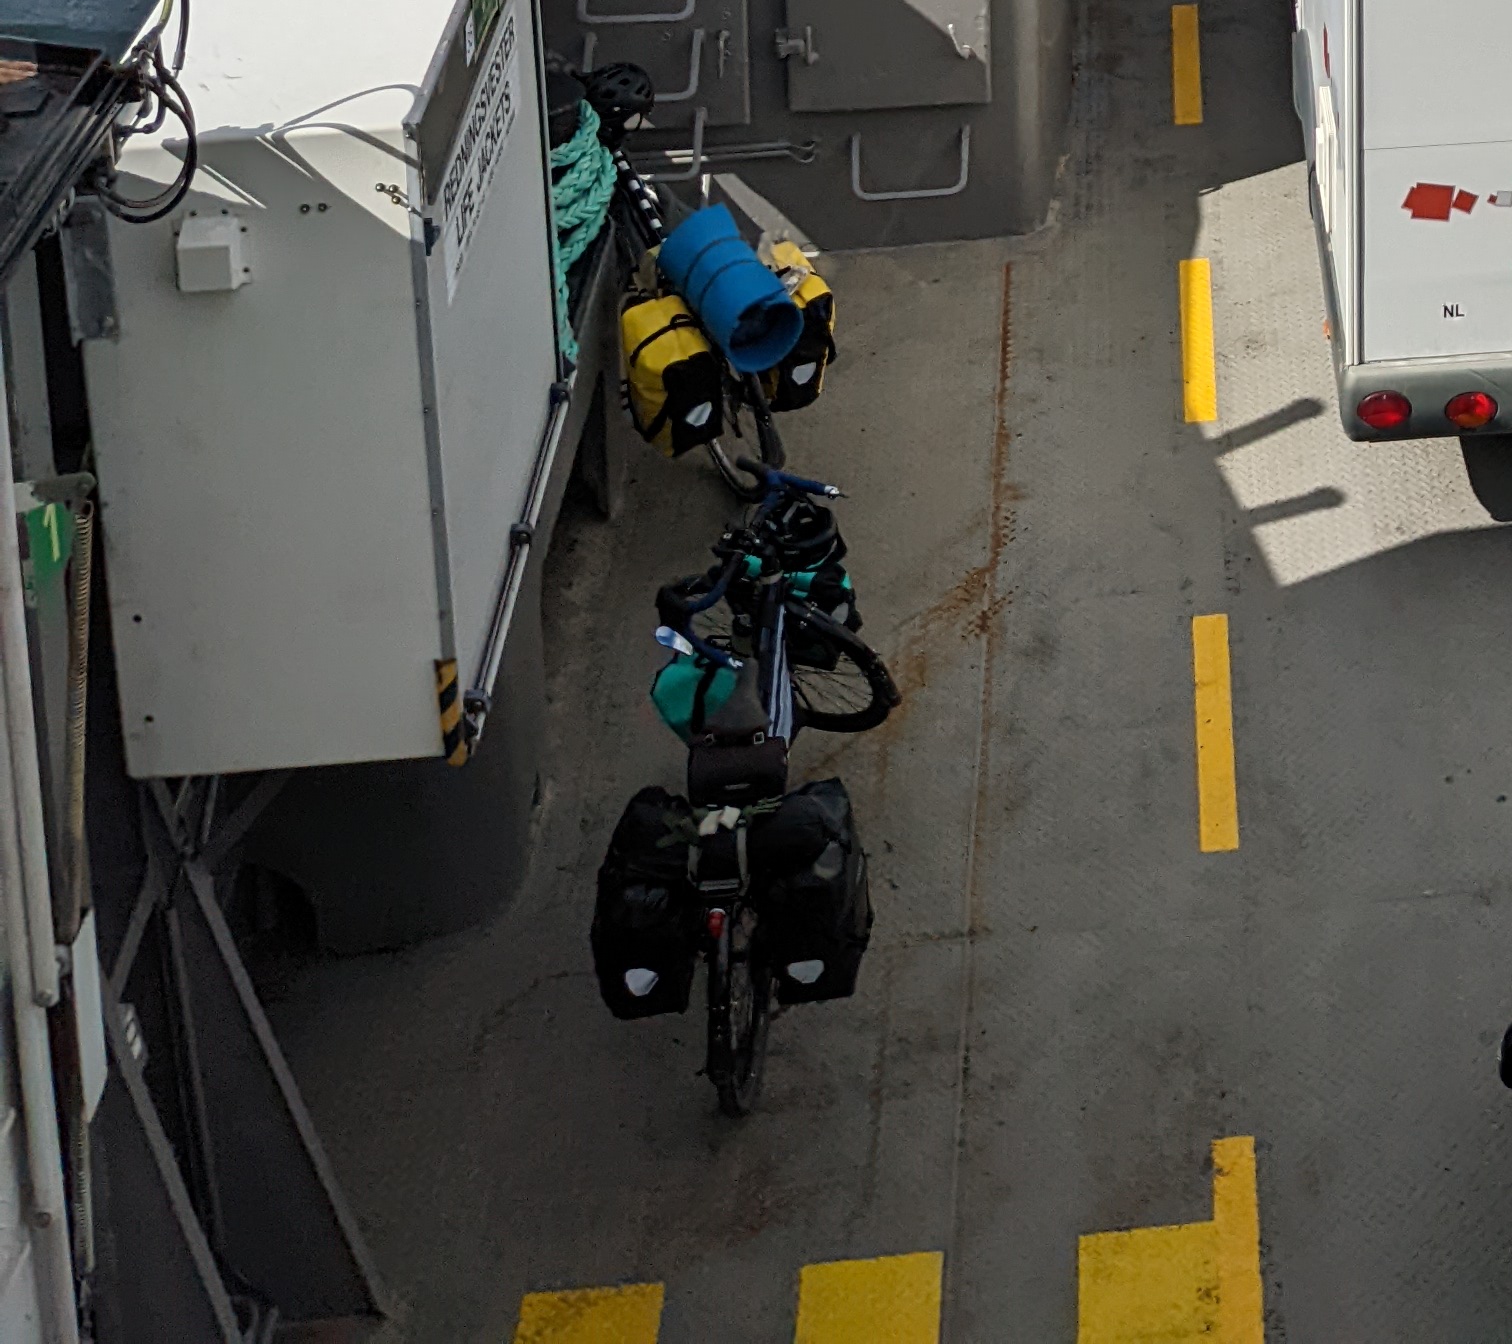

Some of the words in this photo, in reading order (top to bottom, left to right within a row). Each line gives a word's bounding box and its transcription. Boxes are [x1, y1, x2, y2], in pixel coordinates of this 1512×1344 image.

[443, 15, 515, 222] REDNINGSVESTER
[455, 176, 475, 247] LIFE
[476, 80, 511, 193] JACKETS
[1443, 304, 1465, 318] NL
[43, 502, 61, 562] 1
